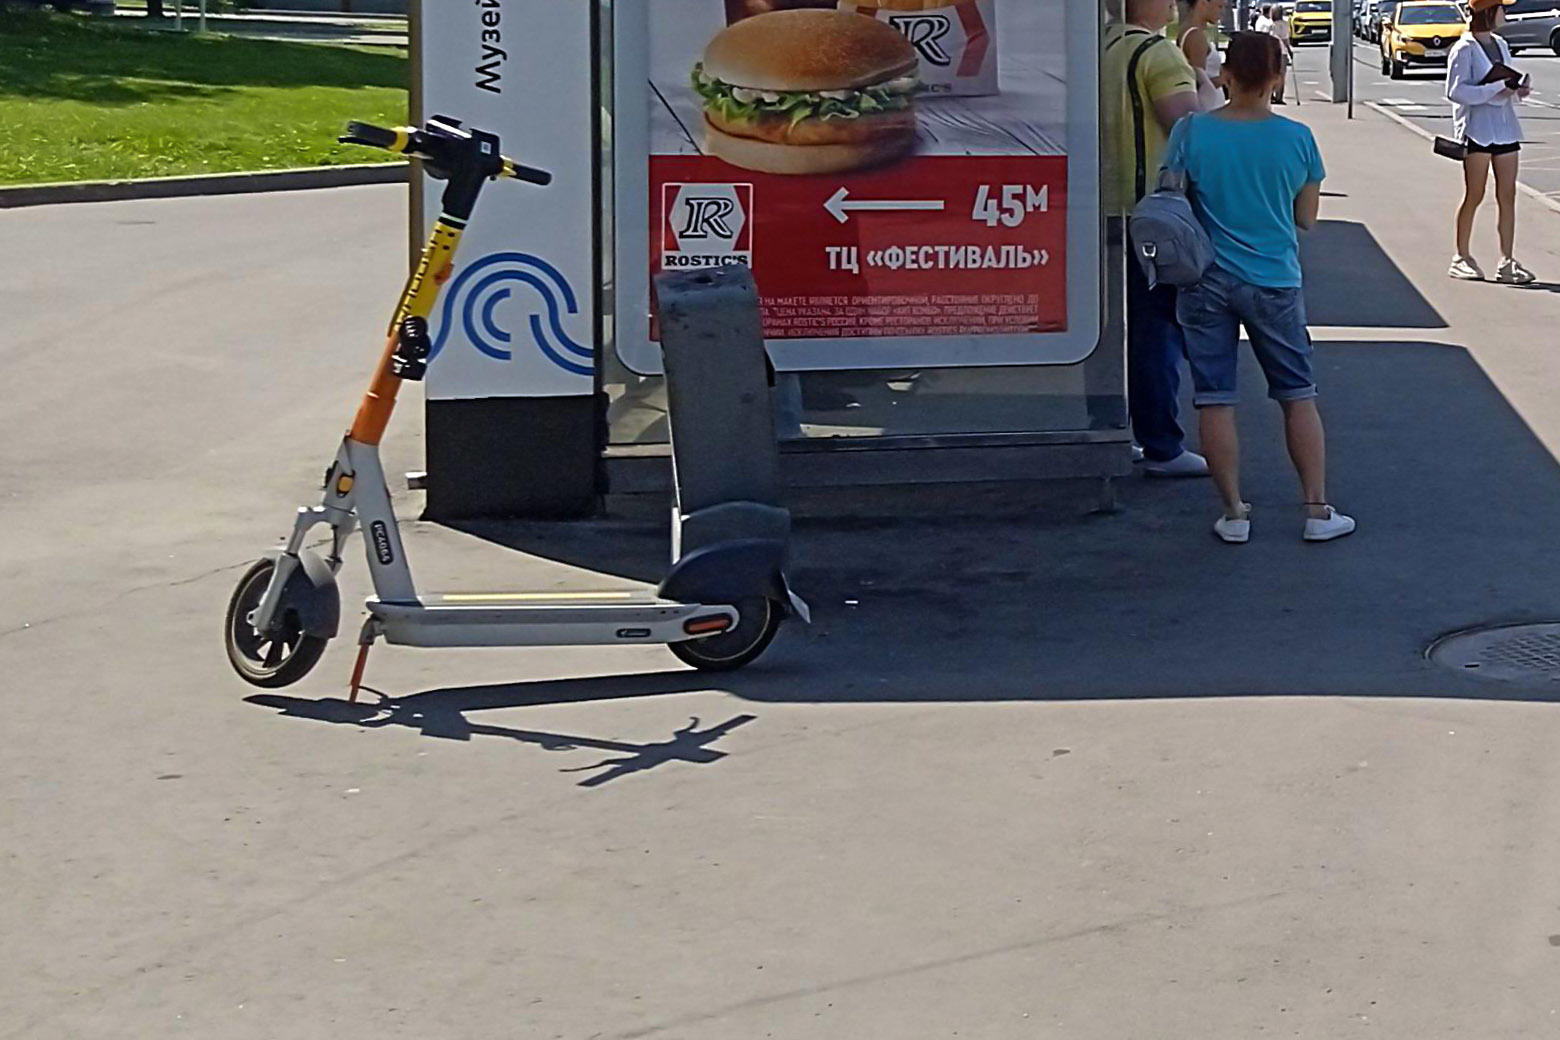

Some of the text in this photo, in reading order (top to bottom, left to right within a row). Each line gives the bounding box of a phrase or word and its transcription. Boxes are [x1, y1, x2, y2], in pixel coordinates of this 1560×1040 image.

[679, 196, 735, 239] R
[972, 184, 1048, 227] 45М
[664, 255, 748, 266] ROSTIC'S
[825, 245, 1049, 274] ТЦ «ФЕСТИВАЛЬ»
